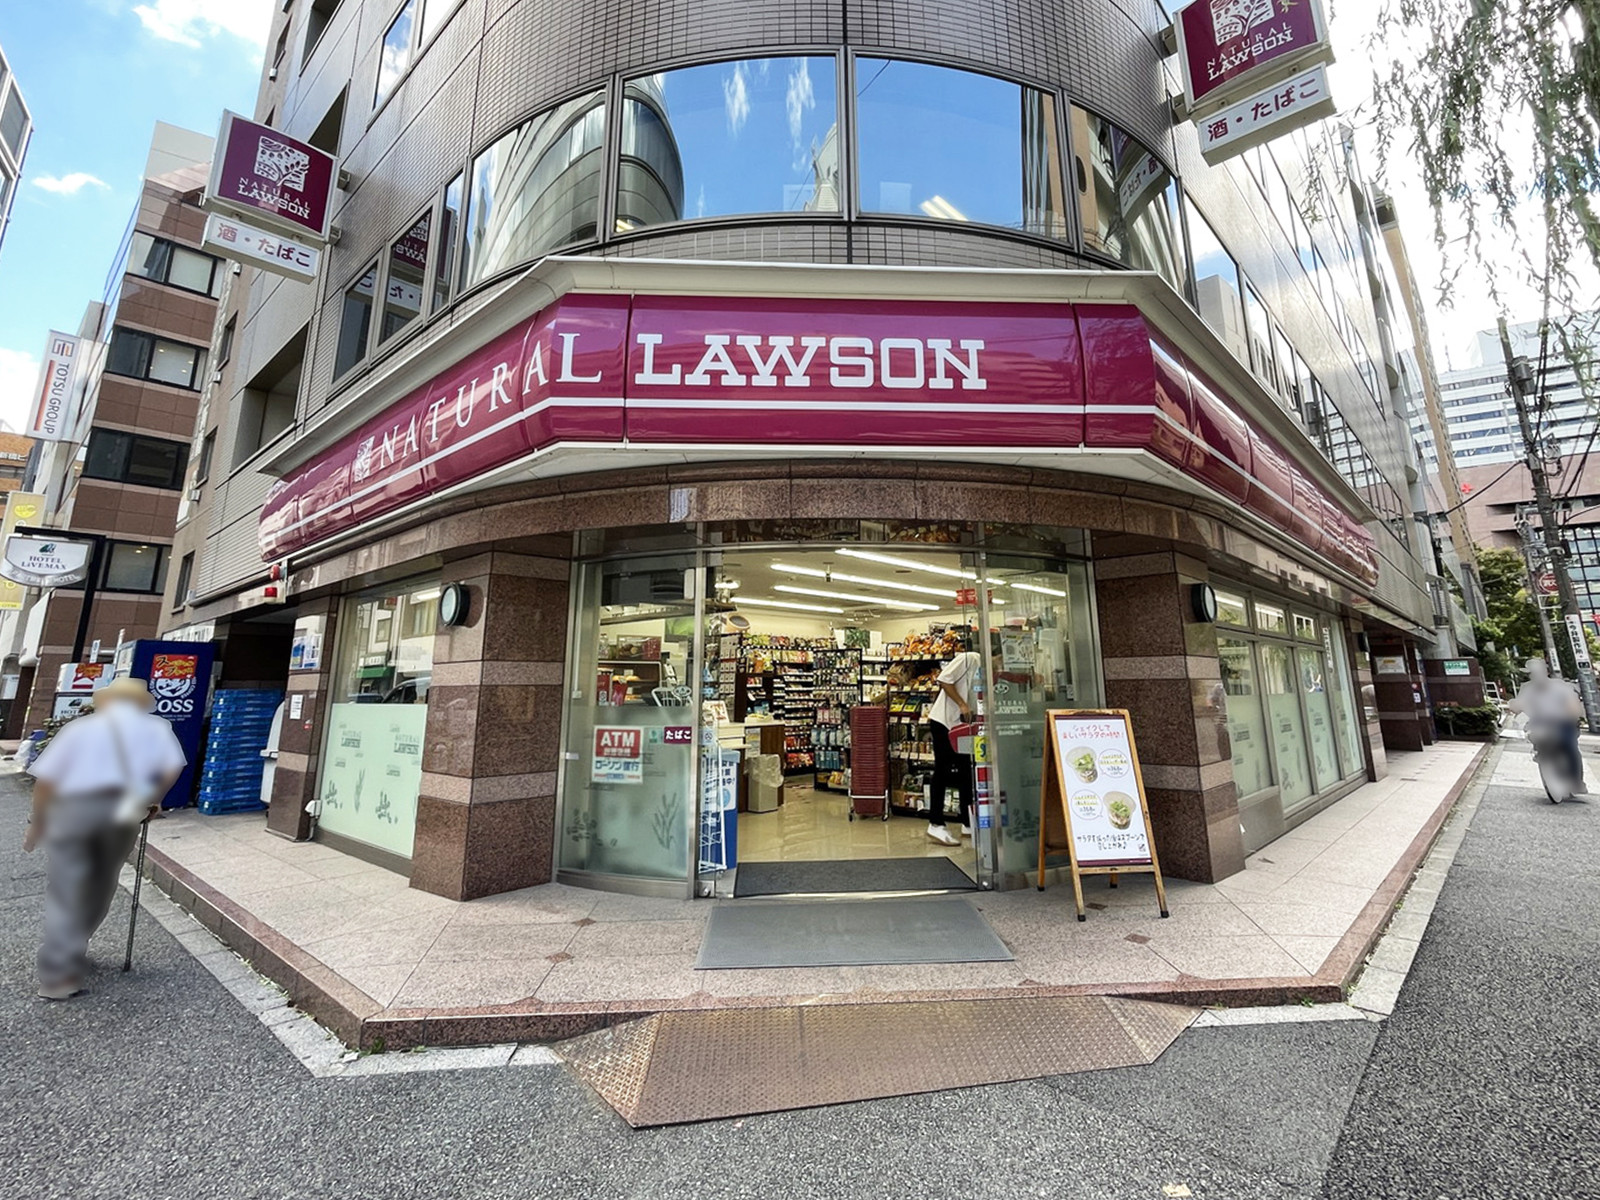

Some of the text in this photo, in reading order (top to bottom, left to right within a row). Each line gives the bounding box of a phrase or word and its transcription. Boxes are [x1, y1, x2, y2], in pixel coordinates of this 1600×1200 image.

[1206, 22, 1292, 69] NATURAL
[1208, 29, 1294, 81] LAWSON
[1208, 78, 1320, 142] 酒・たばこ
[237, 183, 310, 219] LAWSON
[239, 177, 311, 211] NATURAL
[217, 222, 311, 268] 酒・たばこ
[43, 363, 70, 434] TOTSU GROUP
[378, 333, 987, 471] NATURAL LAWSON
[29, 555, 62, 563] HOTEL
[157, 699, 194, 713] OSS
[600, 731, 635, 748] ATM
[665, 729, 691, 740] たばこ
[594, 759, 640, 772] ローソン銀行
